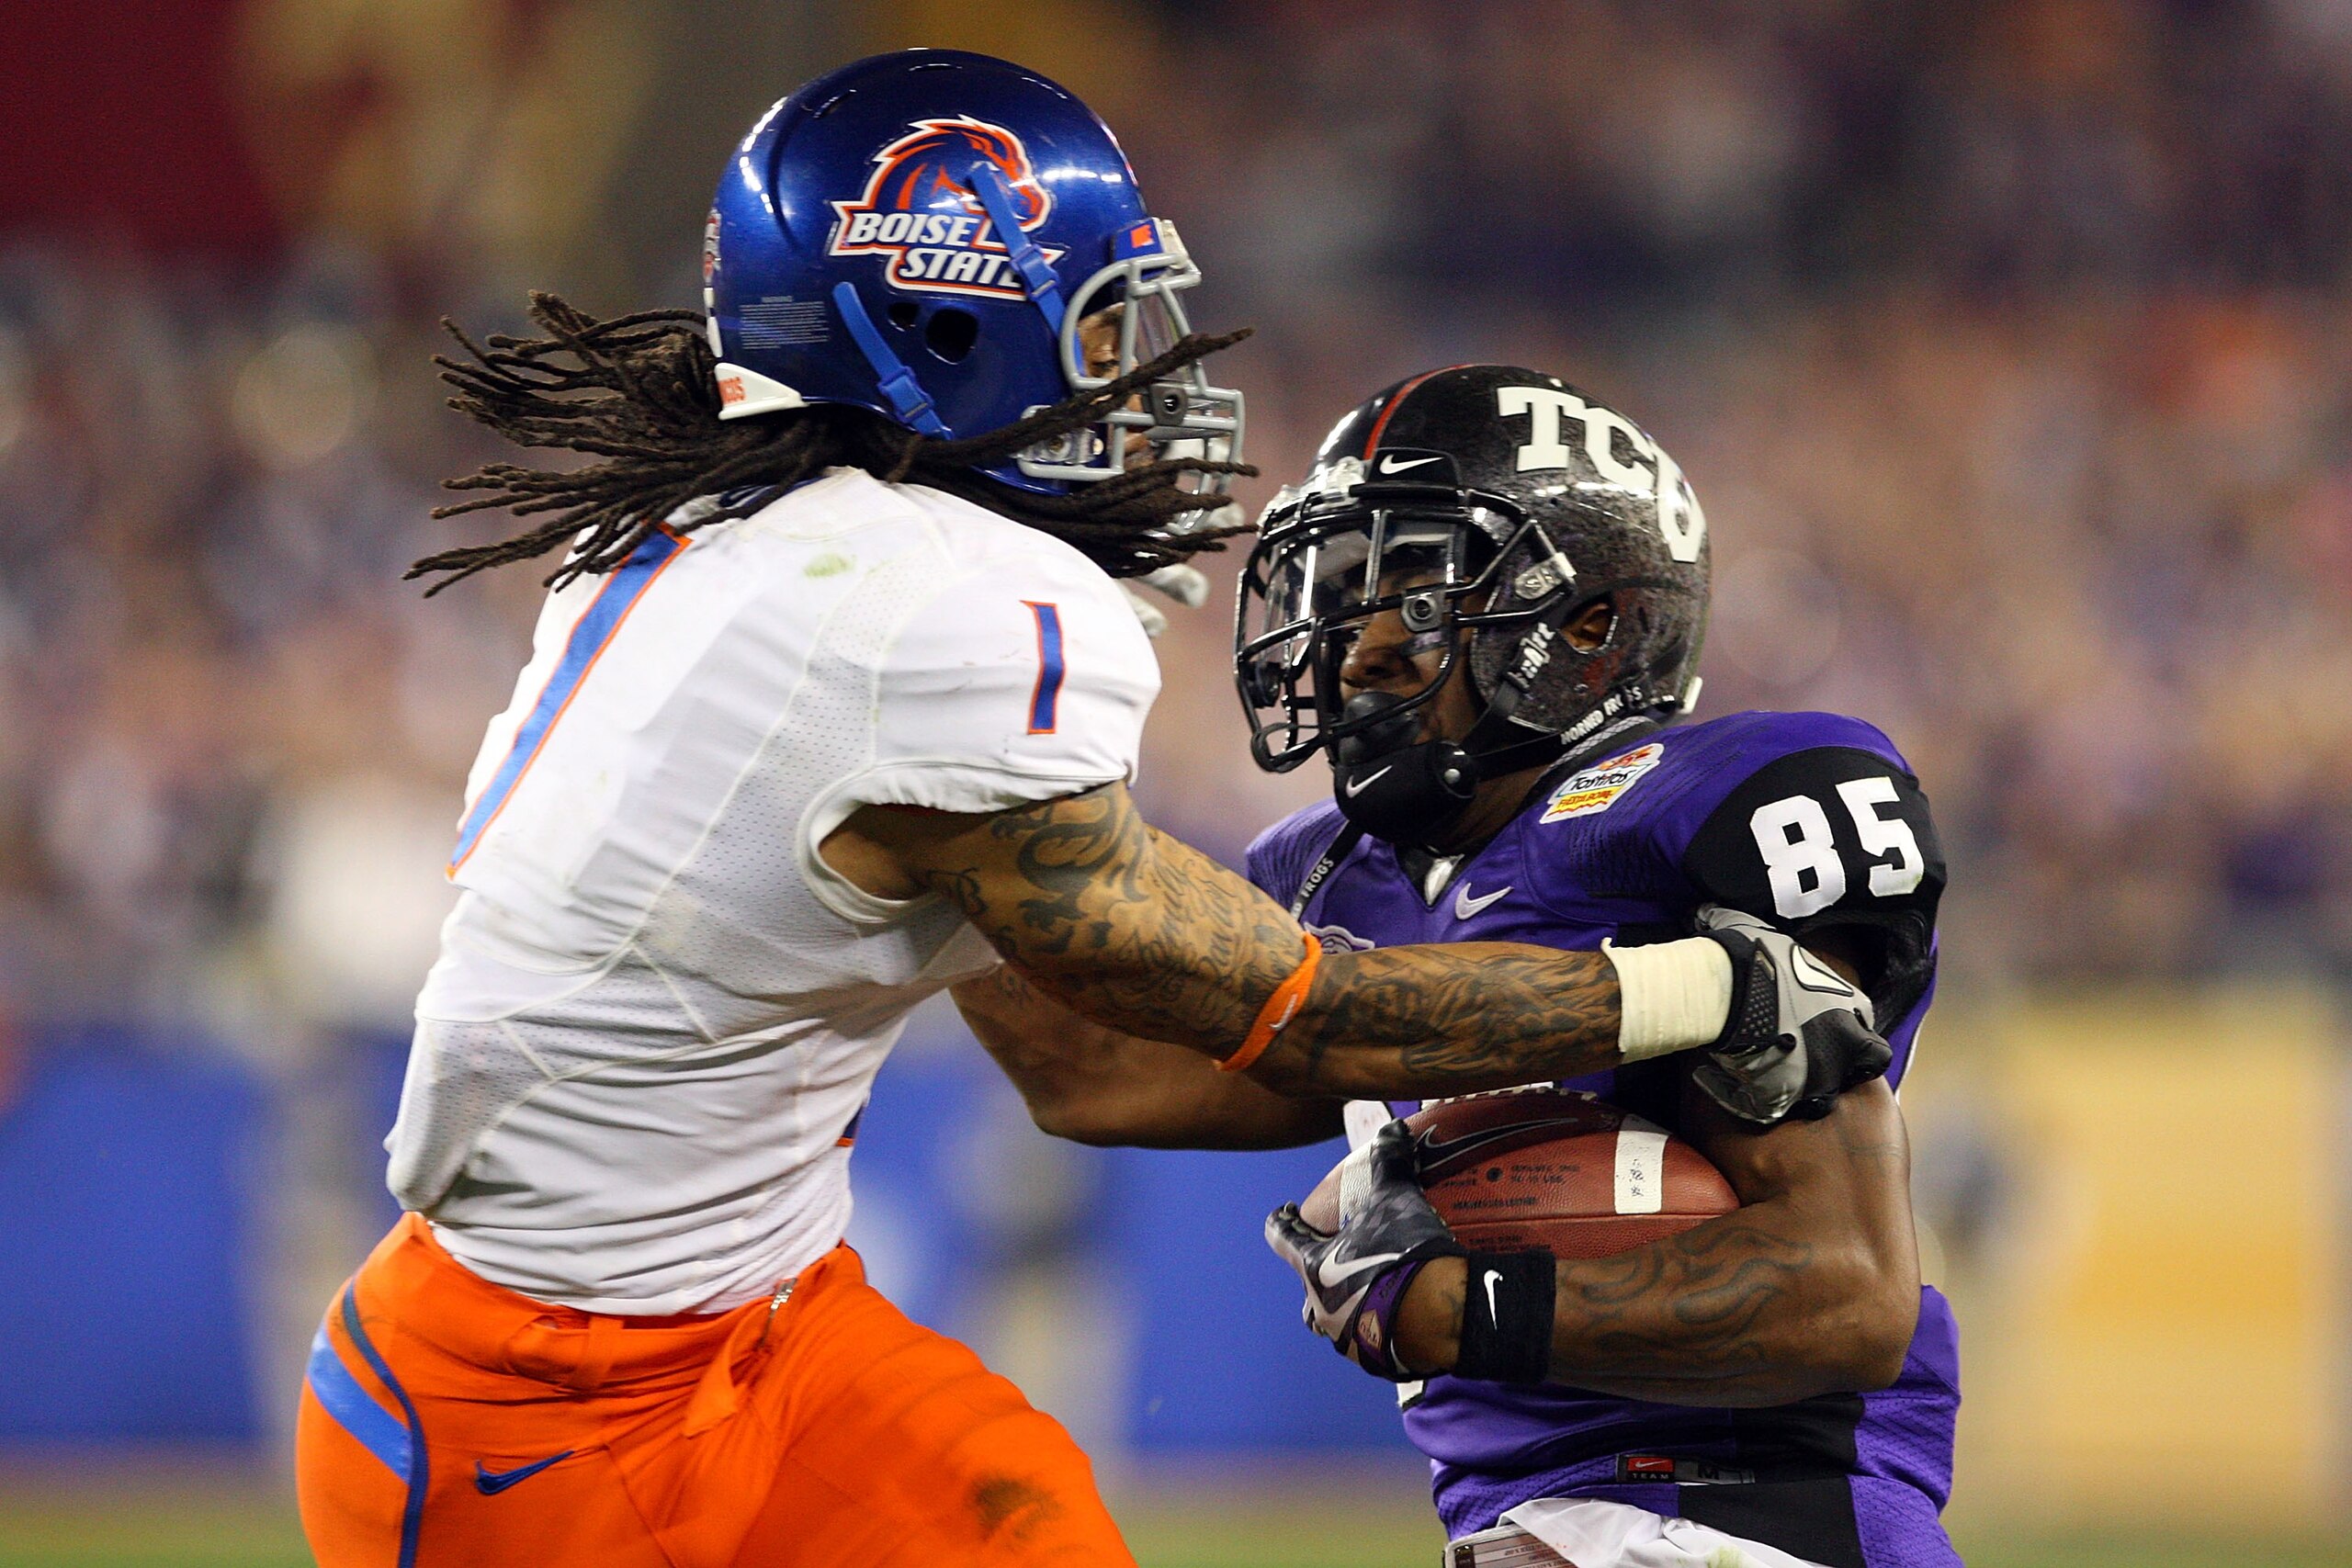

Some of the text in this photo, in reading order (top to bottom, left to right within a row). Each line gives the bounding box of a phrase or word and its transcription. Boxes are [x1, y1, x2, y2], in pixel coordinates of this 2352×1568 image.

[846, 213, 980, 246] BOISE
[1497, 386, 1706, 562] TCU
[1019, 599, 1066, 735] 1
[1560, 686, 1643, 745] HORNED FRS
[1571, 770, 1636, 791] Tostitos
[1300, 857, 1334, 897] FROGS
[1749, 776, 1925, 919] 85
